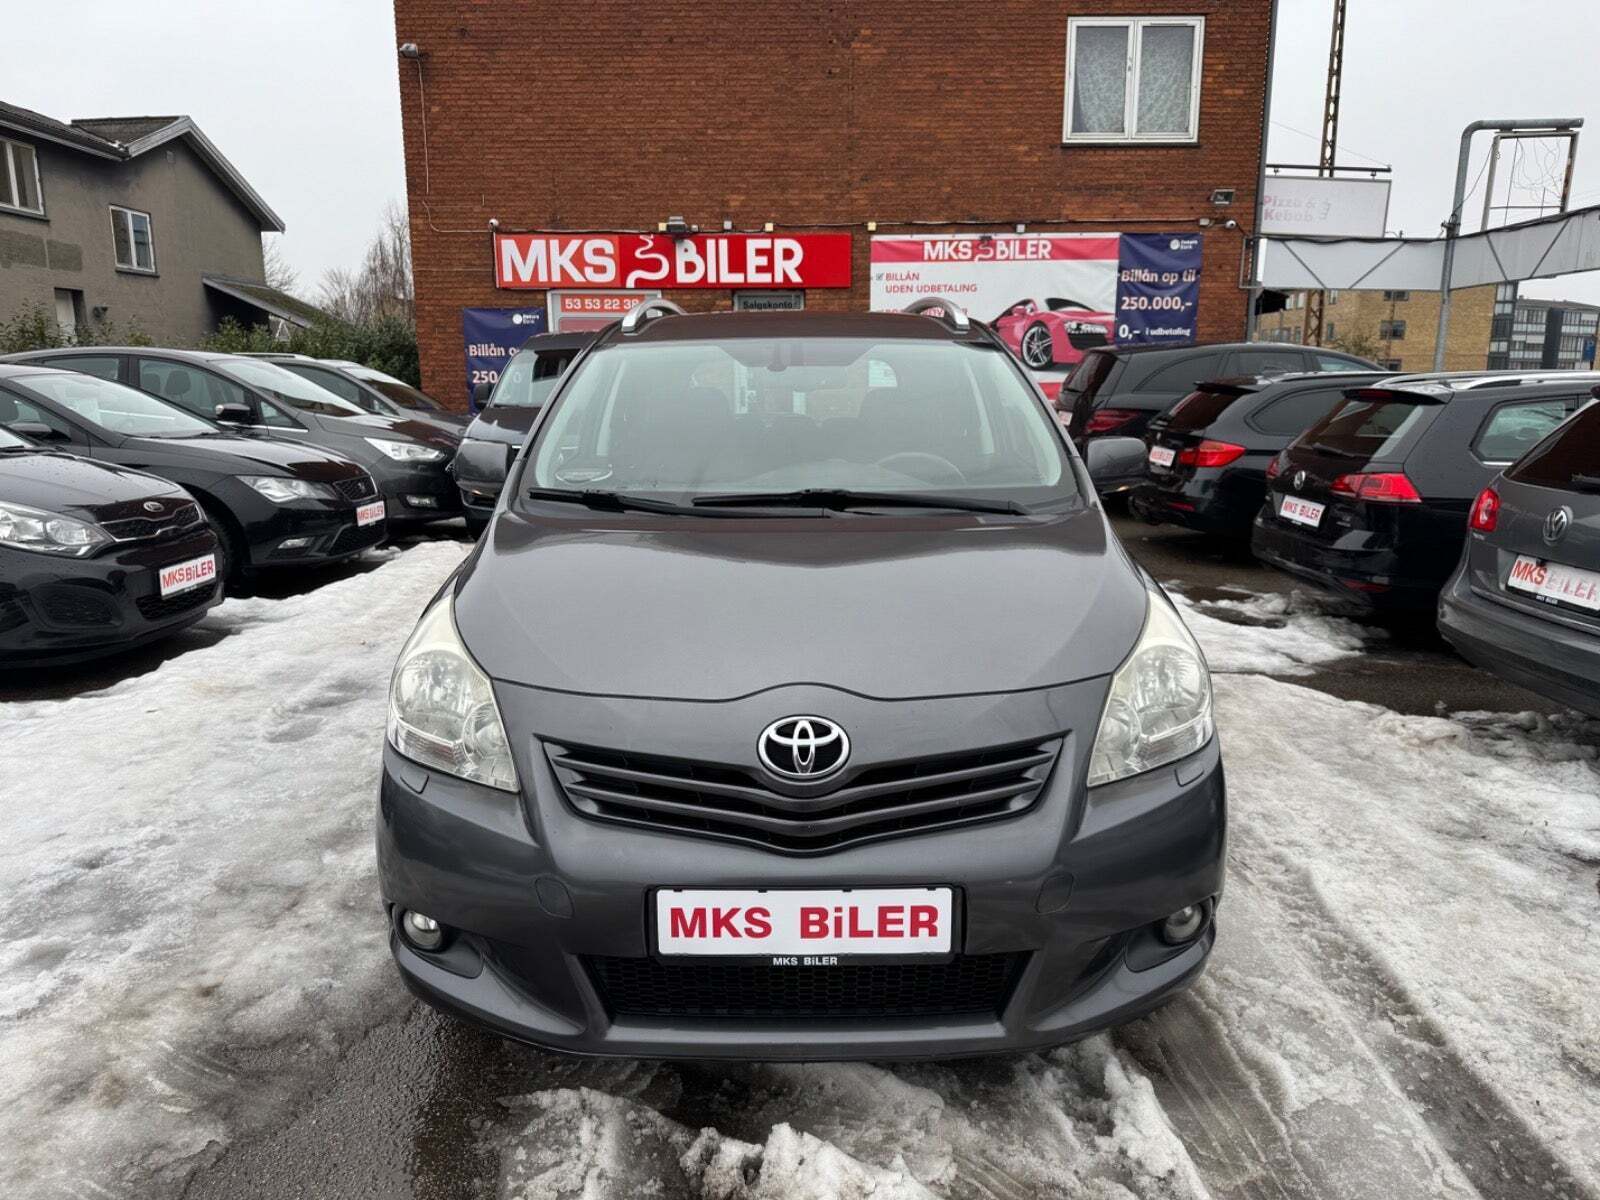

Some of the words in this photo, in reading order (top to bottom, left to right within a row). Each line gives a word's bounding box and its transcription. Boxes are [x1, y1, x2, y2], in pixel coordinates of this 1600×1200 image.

[923, 240, 972, 260] MKS
[996, 239, 1052, 260] BILER
[501, 239, 617, 283] MKS
[675, 238, 804, 284] BILER
[885, 271, 920, 281] BILLÅN
[1121, 268, 1158, 282] Billån
[1162, 272, 1178, 285] op
[1182, 269, 1196, 282] til
[885, 284, 913, 293] UDEN
[916, 283, 977, 293] UDBETALING
[565, 299, 581, 310] 53
[585, 299, 601, 310] 53
[604, 299, 620, 310] 22
[1150, 327, 1191, 337] udbetaling
[468, 343, 505, 357] Billån
[1283, 501, 1298, 513] MKS
[162, 567, 185, 588] MKS
[1511, 559, 1548, 586] MKS
[670, 907, 773, 939] MKS
[772, 957, 799, 966] MKS
